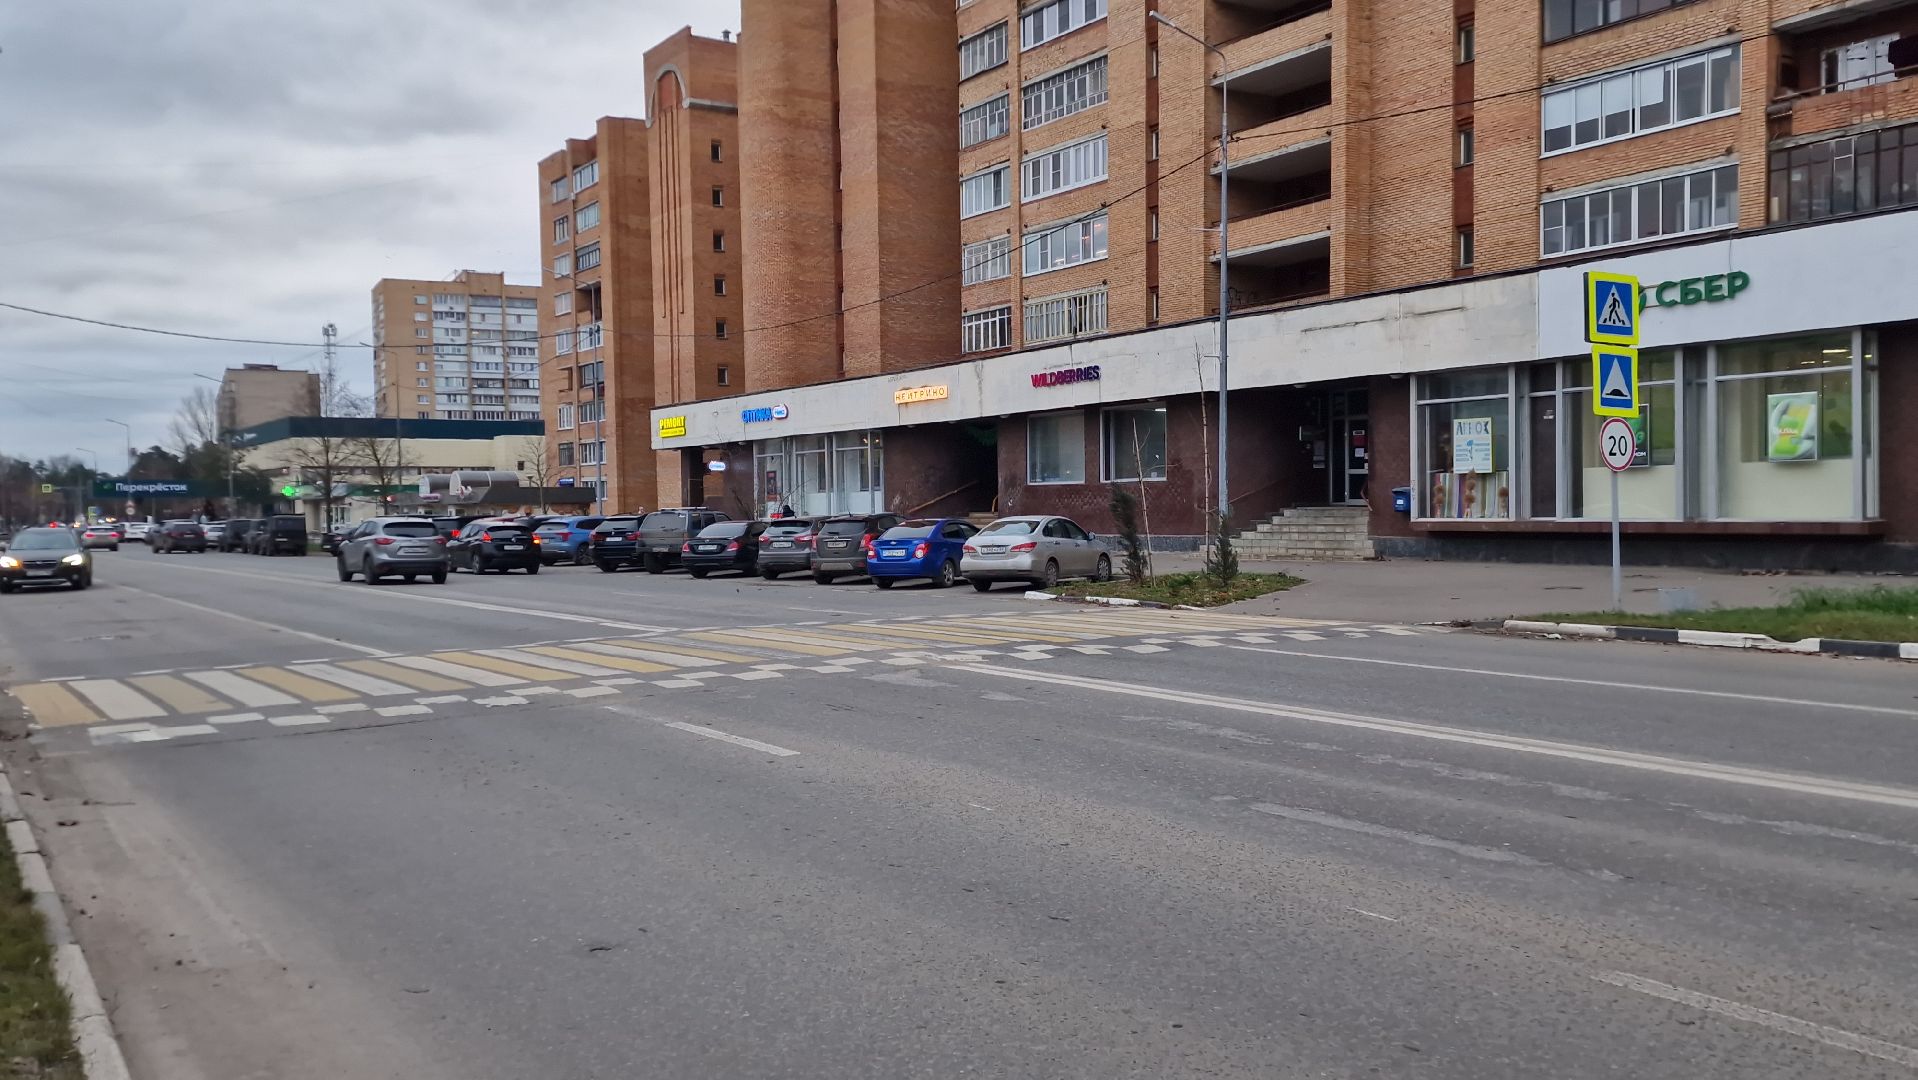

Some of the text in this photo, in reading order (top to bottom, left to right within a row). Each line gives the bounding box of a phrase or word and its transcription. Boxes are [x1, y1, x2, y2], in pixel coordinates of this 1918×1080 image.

[1656, 271, 1750, 307] СБЕР
[1031, 365, 1101, 388] WILDBERRIES
[659, 416, 685, 429] РЕМОНТ
[1608, 435, 1628, 456] 20
[115, 482, 188, 493] Перекрёсток
